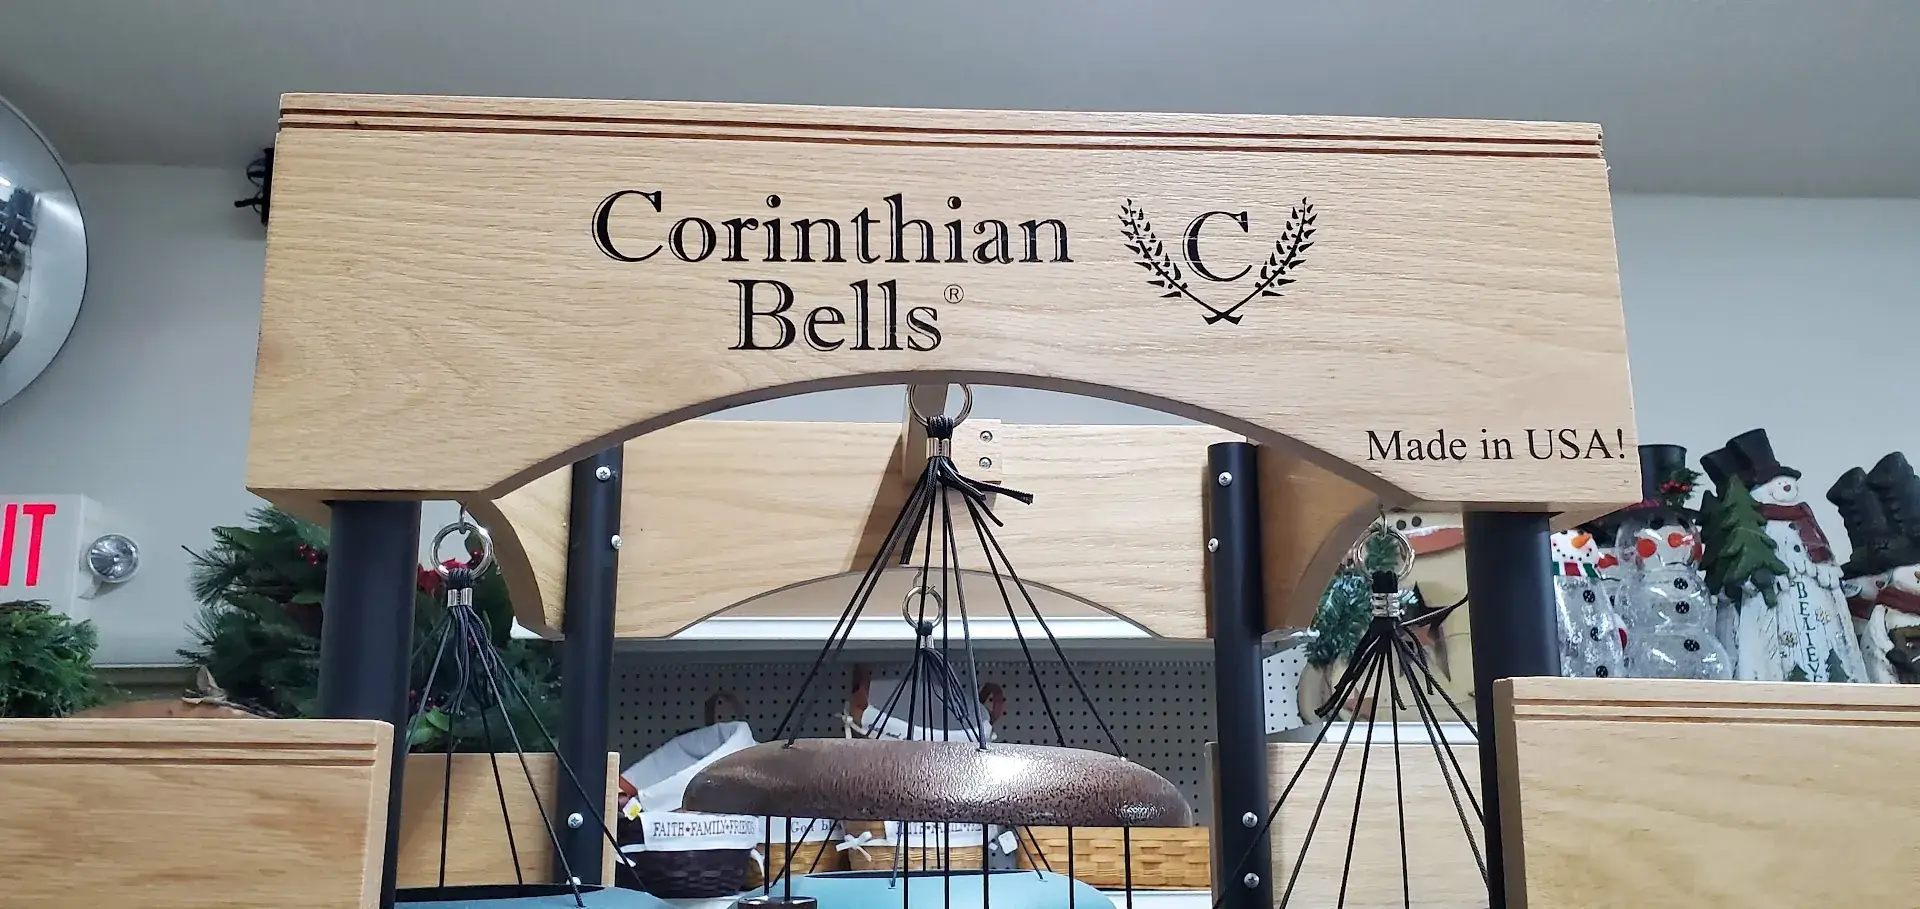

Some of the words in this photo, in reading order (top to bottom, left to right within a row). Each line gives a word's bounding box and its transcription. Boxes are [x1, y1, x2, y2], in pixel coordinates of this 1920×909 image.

[591, 190, 1074, 264] Corinthian
[1182, 210, 1252, 282] C
[1365, 428, 1467, 460] Made
[1480, 428, 1514, 460] in
[1525, 428, 1625, 460] USA!
